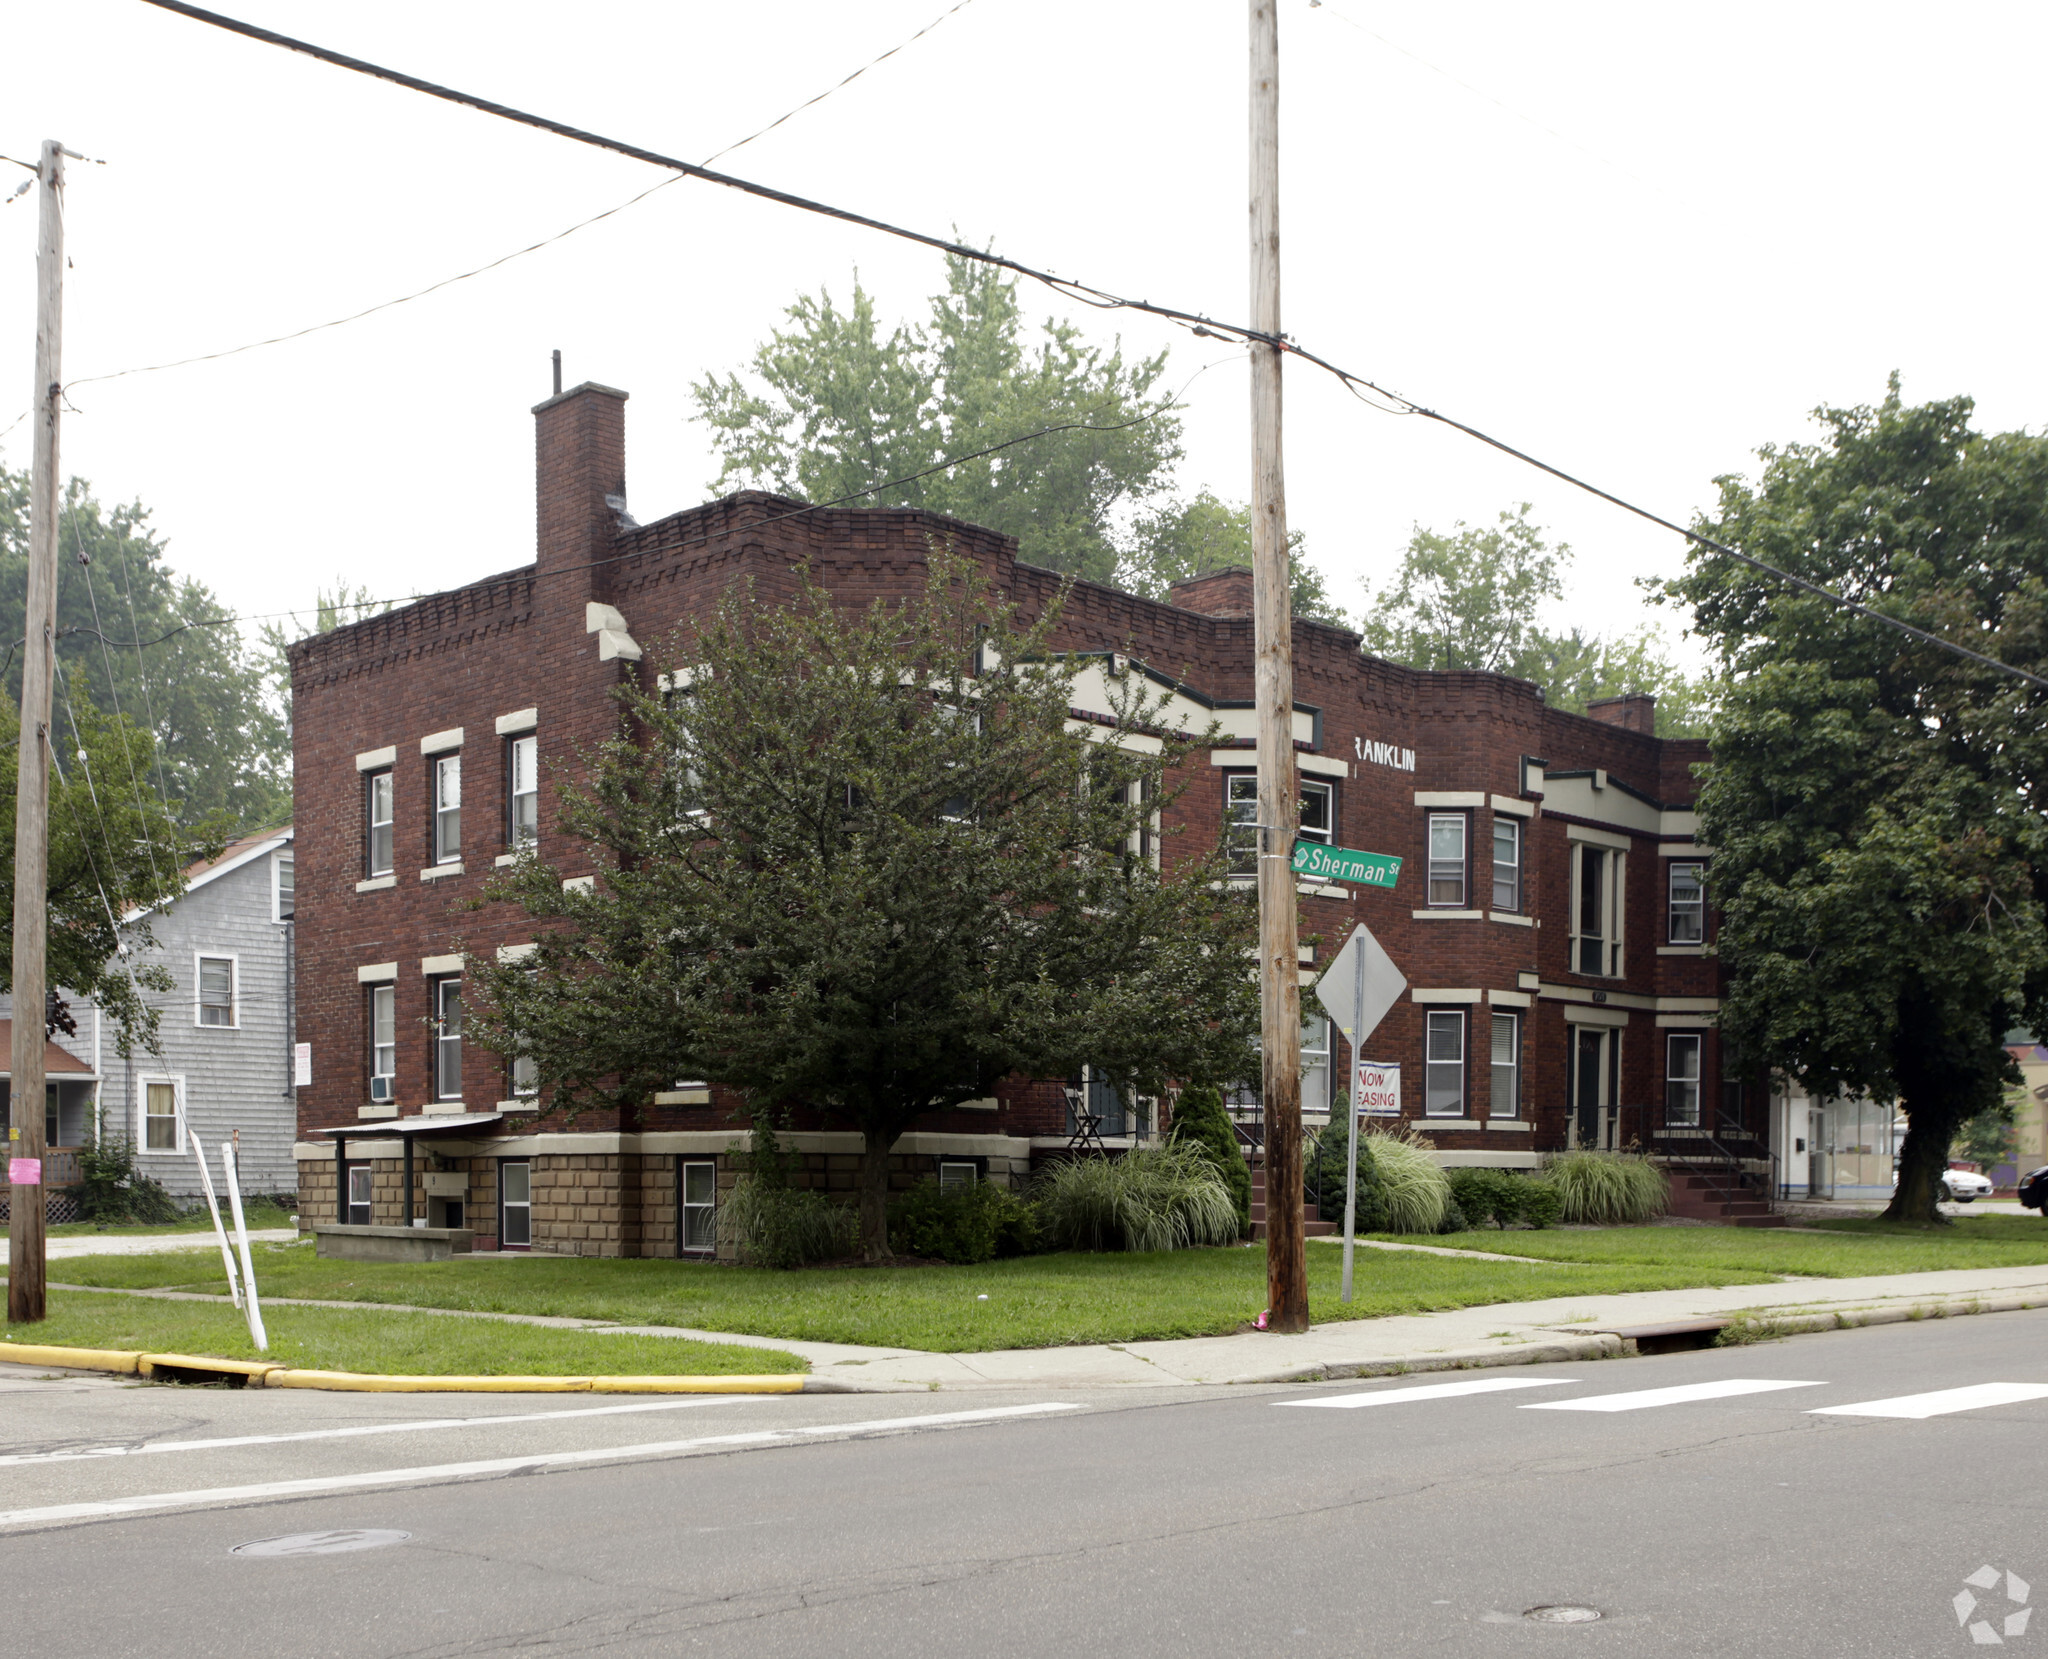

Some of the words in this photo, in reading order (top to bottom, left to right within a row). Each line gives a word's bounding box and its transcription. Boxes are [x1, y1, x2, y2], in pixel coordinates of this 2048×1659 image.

[1355, 737, 1415, 771] RANKLIN
[1308, 848, 1385, 882] Sherman
[1389, 862, 1400, 876] St
[1359, 1070, 1385, 1087] NOW
[1358, 1091, 1395, 1107] EASING
